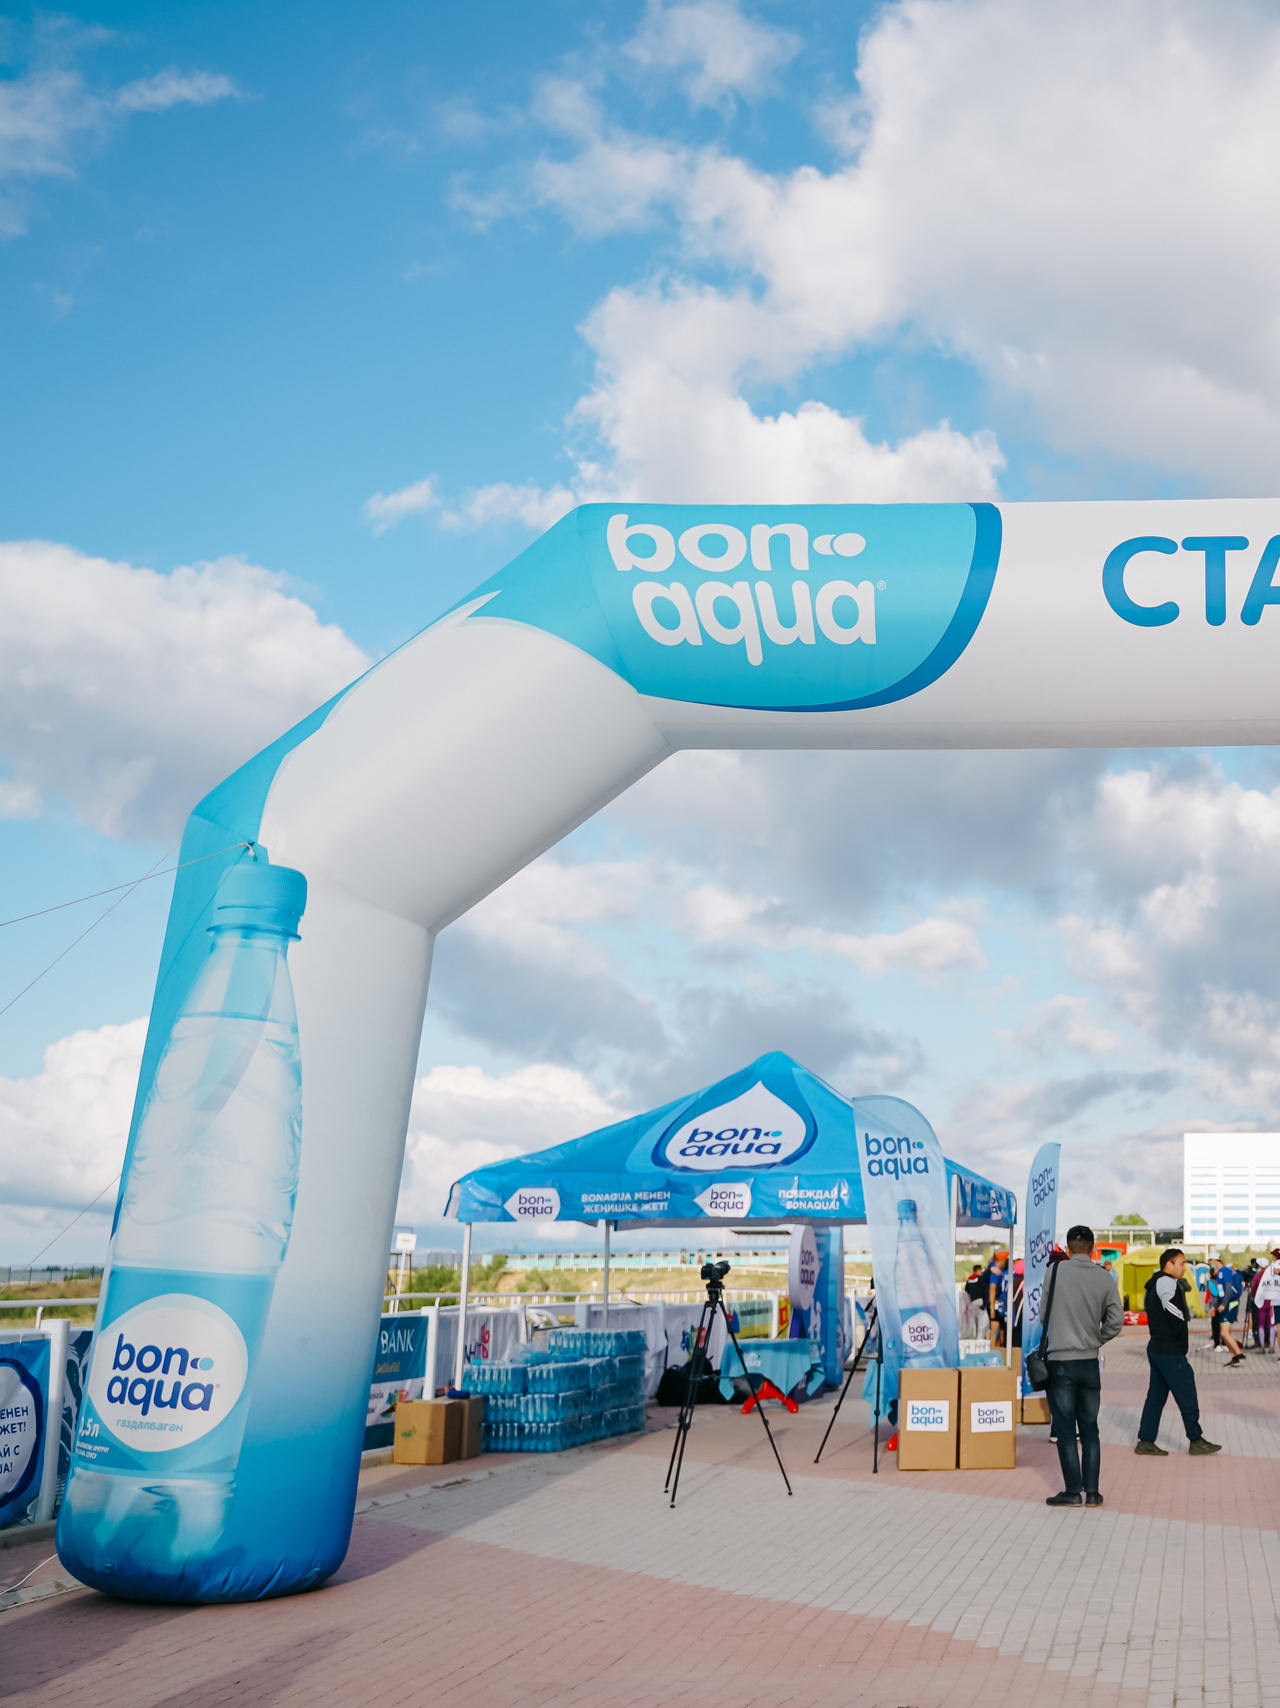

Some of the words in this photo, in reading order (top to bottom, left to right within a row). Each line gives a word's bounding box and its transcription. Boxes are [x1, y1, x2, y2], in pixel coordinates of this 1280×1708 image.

[606, 513, 810, 573] bon
[631, 579, 877, 666] aqua
[686, 1127, 762, 1144] bon
[864, 1132, 911, 1157] bon
[867, 1156, 929, 1181] aqua
[1032, 1166, 1048, 1193] bon
[518, 1193, 544, 1205] bon
[580, 1191, 632, 1203] BONAQUA
[634, 1191, 671, 1200] МЕНЕН
[710, 1189, 736, 1200] bon
[518, 1205, 553, 1217] aqua
[640, 1201, 668, 1212] ЖЕТ!
[709, 1200, 744, 1212] aqua
[908, 1324, 929, 1334] bon
[380, 1328, 415, 1355] BANK
[909, 1333, 935, 1344] aqua
[112, 1332, 189, 1376] bon
[106, 1375, 214, 1417] aqua
[911, 1405, 936, 1415] bon
[977, 1408, 998, 1417] bon
[116, 1418, 184, 1433] газдалбаган
[911, 1415, 943, 1426] aqua
[977, 1415, 1005, 1426] aqua
[13, 1444, 20, 1456] С
